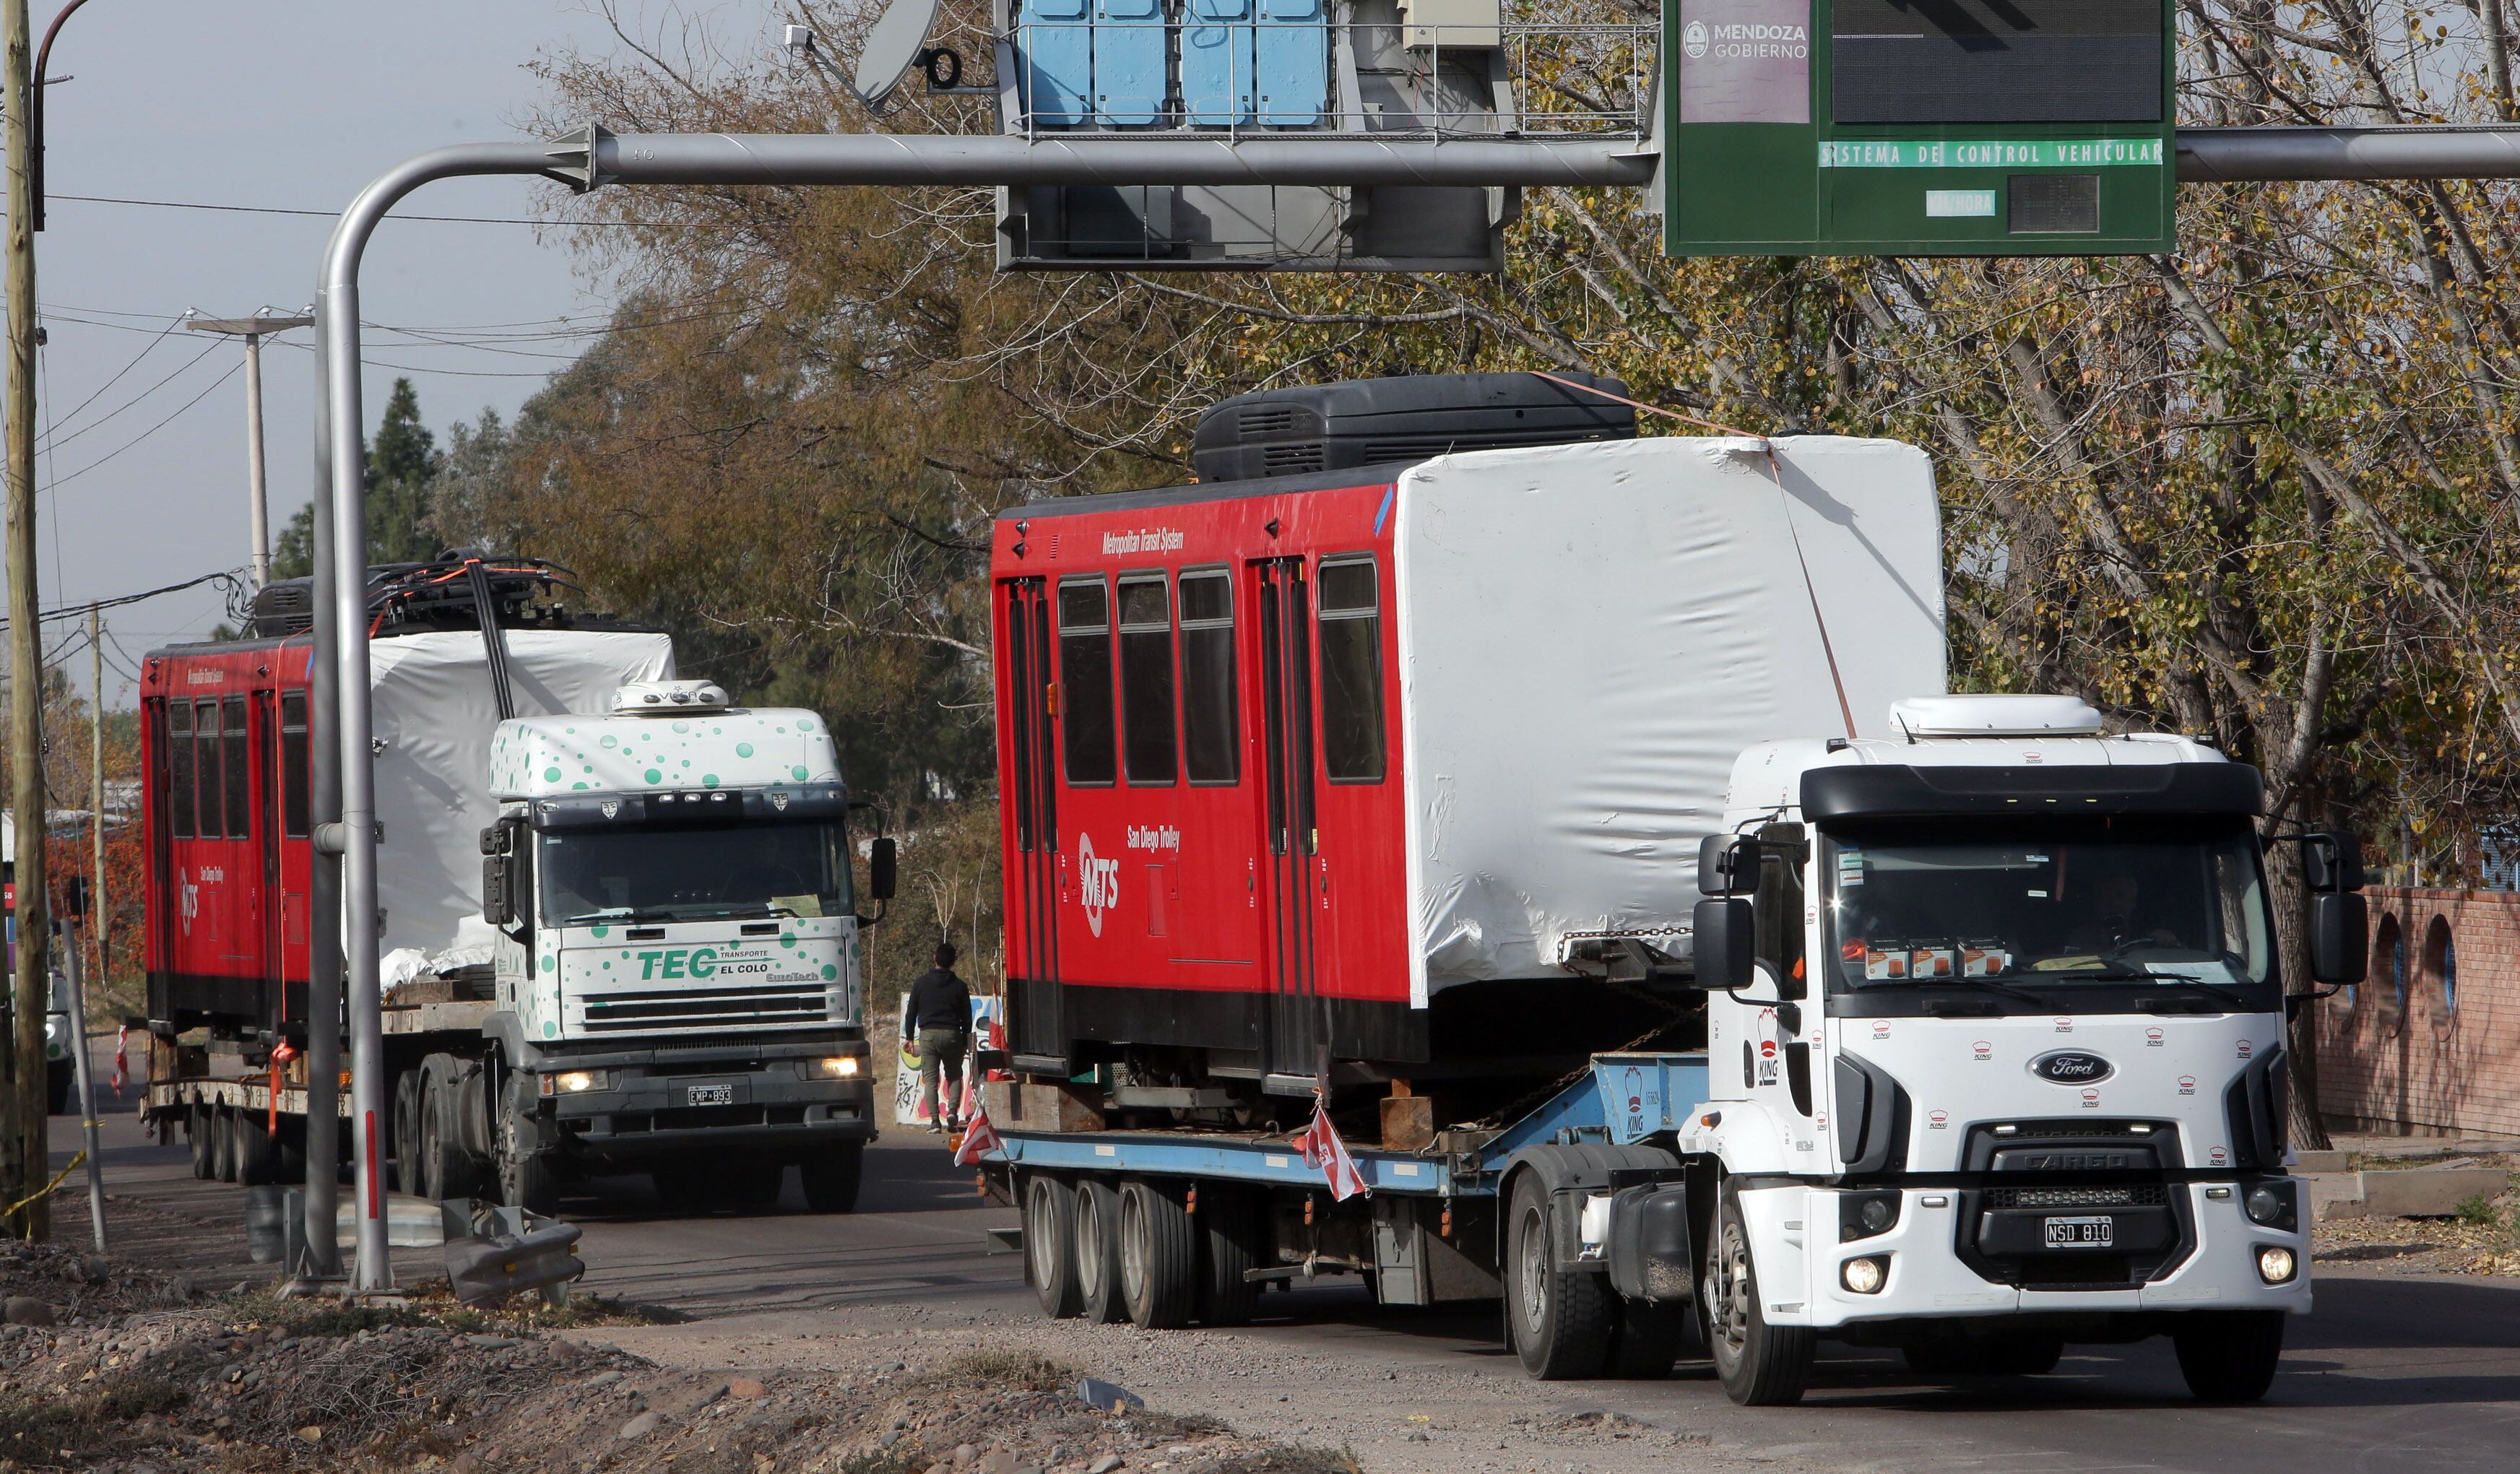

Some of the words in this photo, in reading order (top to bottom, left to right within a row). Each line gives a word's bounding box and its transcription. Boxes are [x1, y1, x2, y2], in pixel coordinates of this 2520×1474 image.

[1714, 24, 1806, 40] MENDOZA
[1715, 44, 1807, 58] GOBIERNO
[1822, 146, 1900, 162] SISTEMA
[1918, 146, 1939, 162] DE
[1957, 144, 2040, 162] CONTROL
[2057, 143, 2162, 162] VEHICULAR
[1102, 529, 1140, 559] Metropolitan
[1140, 527, 1161, 552] Transit
[1160, 526, 1184, 555] System
[1127, 825, 1140, 849] San
[1140, 825, 1159, 853] Diego
[1159, 825, 1180, 853] Trolley
[1081, 858, 1119, 909] MTS
[737, 964, 768, 974] COLO
[766, 972, 819, 982] EuroTech
[1759, 1059, 1778, 1082] KING
[2051, 1057, 2095, 1075] Ford
[690, 1091, 708, 1102] EMP
[713, 1090, 731, 1101] 893
[1627, 1114, 1643, 1134] KING
[2025, 1156, 2129, 1169] CARGO
[2048, 1225, 2074, 1241] NSD
[2083, 1224, 2110, 1241] 810
